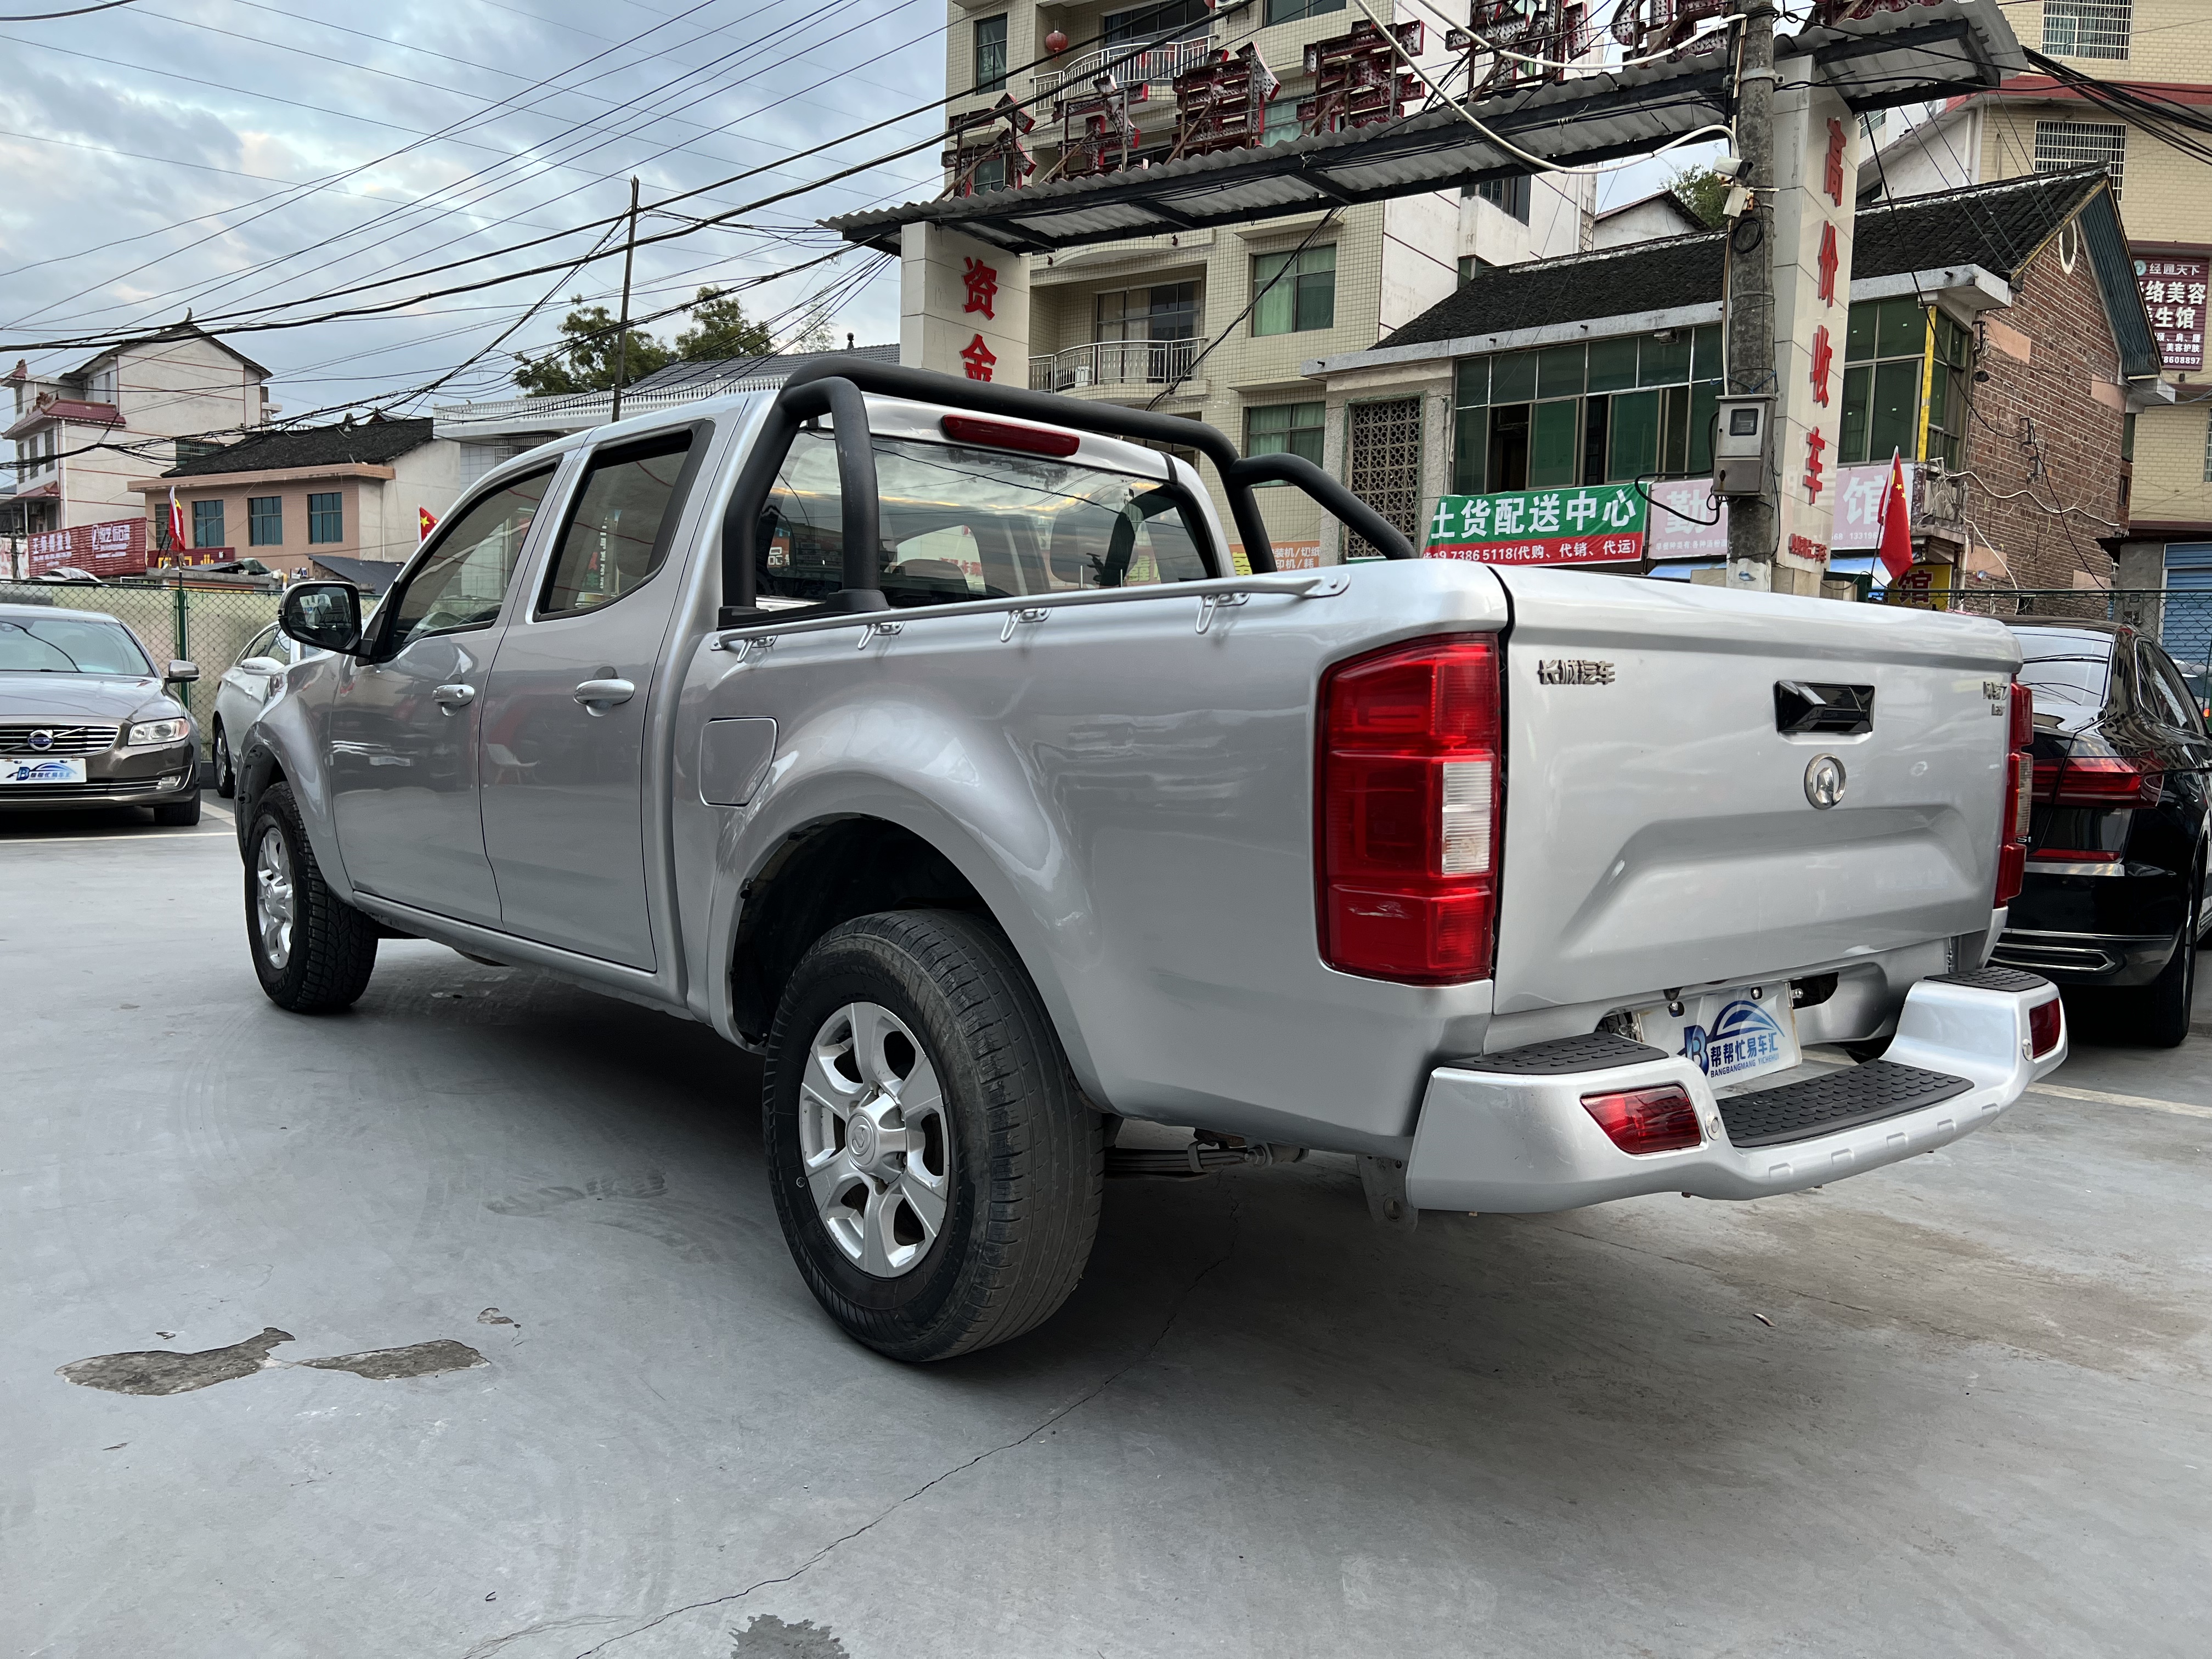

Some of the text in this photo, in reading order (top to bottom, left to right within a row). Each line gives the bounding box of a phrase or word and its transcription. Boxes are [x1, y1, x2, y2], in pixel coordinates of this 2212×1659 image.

[2140, 280, 2206, 305] 络美容
[960, 256, 998, 382] 资金
[1803, 117, 1847, 506] 高价收车
[2162, 356, 2200, 364] 8608897
[1431, 489, 1637, 539] 土货配送中心
[1272, 546, 1320, 558] 装机/切纸
[1538, 659, 1615, 685] 长城汽车
[1711, 1032, 1778, 1067] 帮帮忙易车汇
[1711, 1053, 1779, 1077] BANGBANGMANG YICHEHUI
